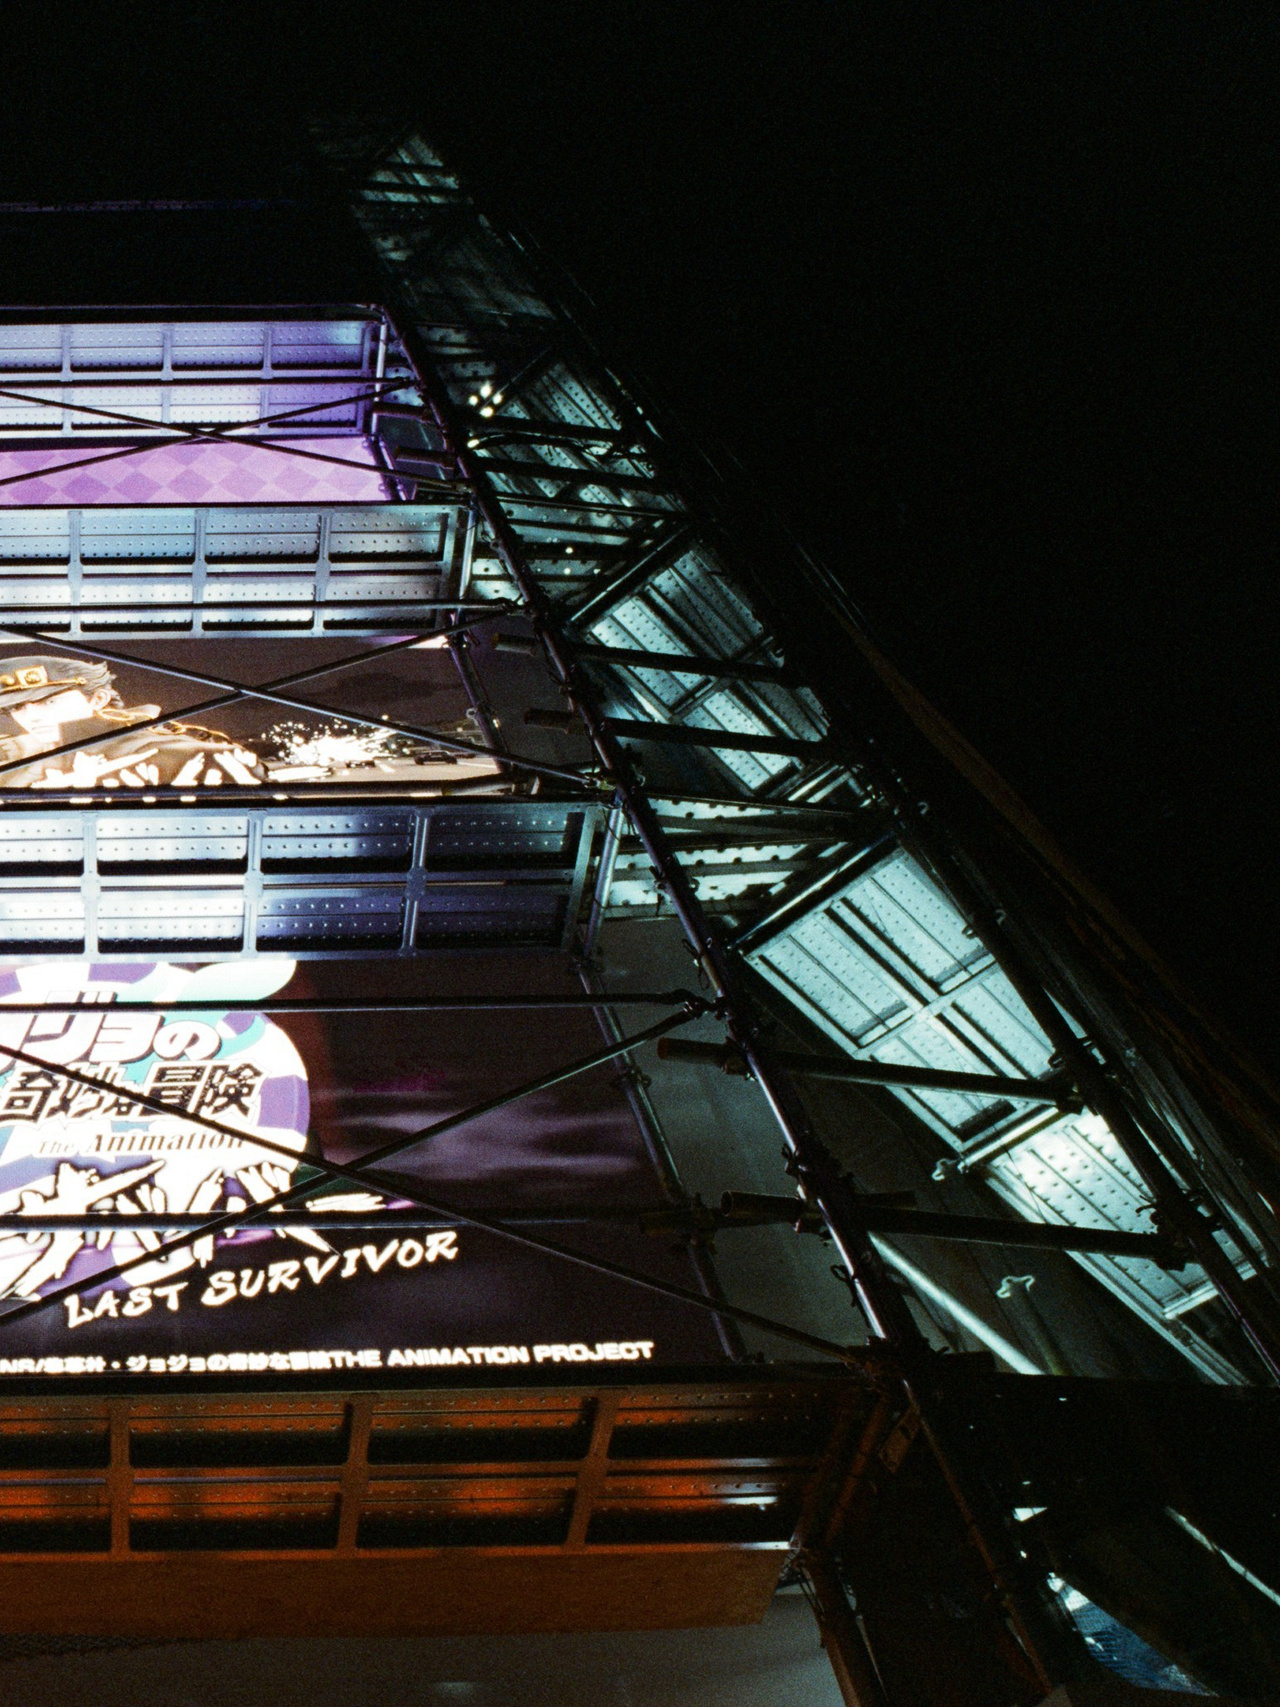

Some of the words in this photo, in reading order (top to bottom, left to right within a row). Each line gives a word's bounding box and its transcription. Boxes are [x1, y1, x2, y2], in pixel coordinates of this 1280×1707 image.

[37, 1141, 77, 1155] The
[86, 1131, 246, 1154] Animation
[63, 1281, 190, 1329] LAST
[200, 1230, 460, 1307] SURVIVOR
[387, 1346, 530, 1368] ANIMATION
[531, 1341, 655, 1363] PROJECT
